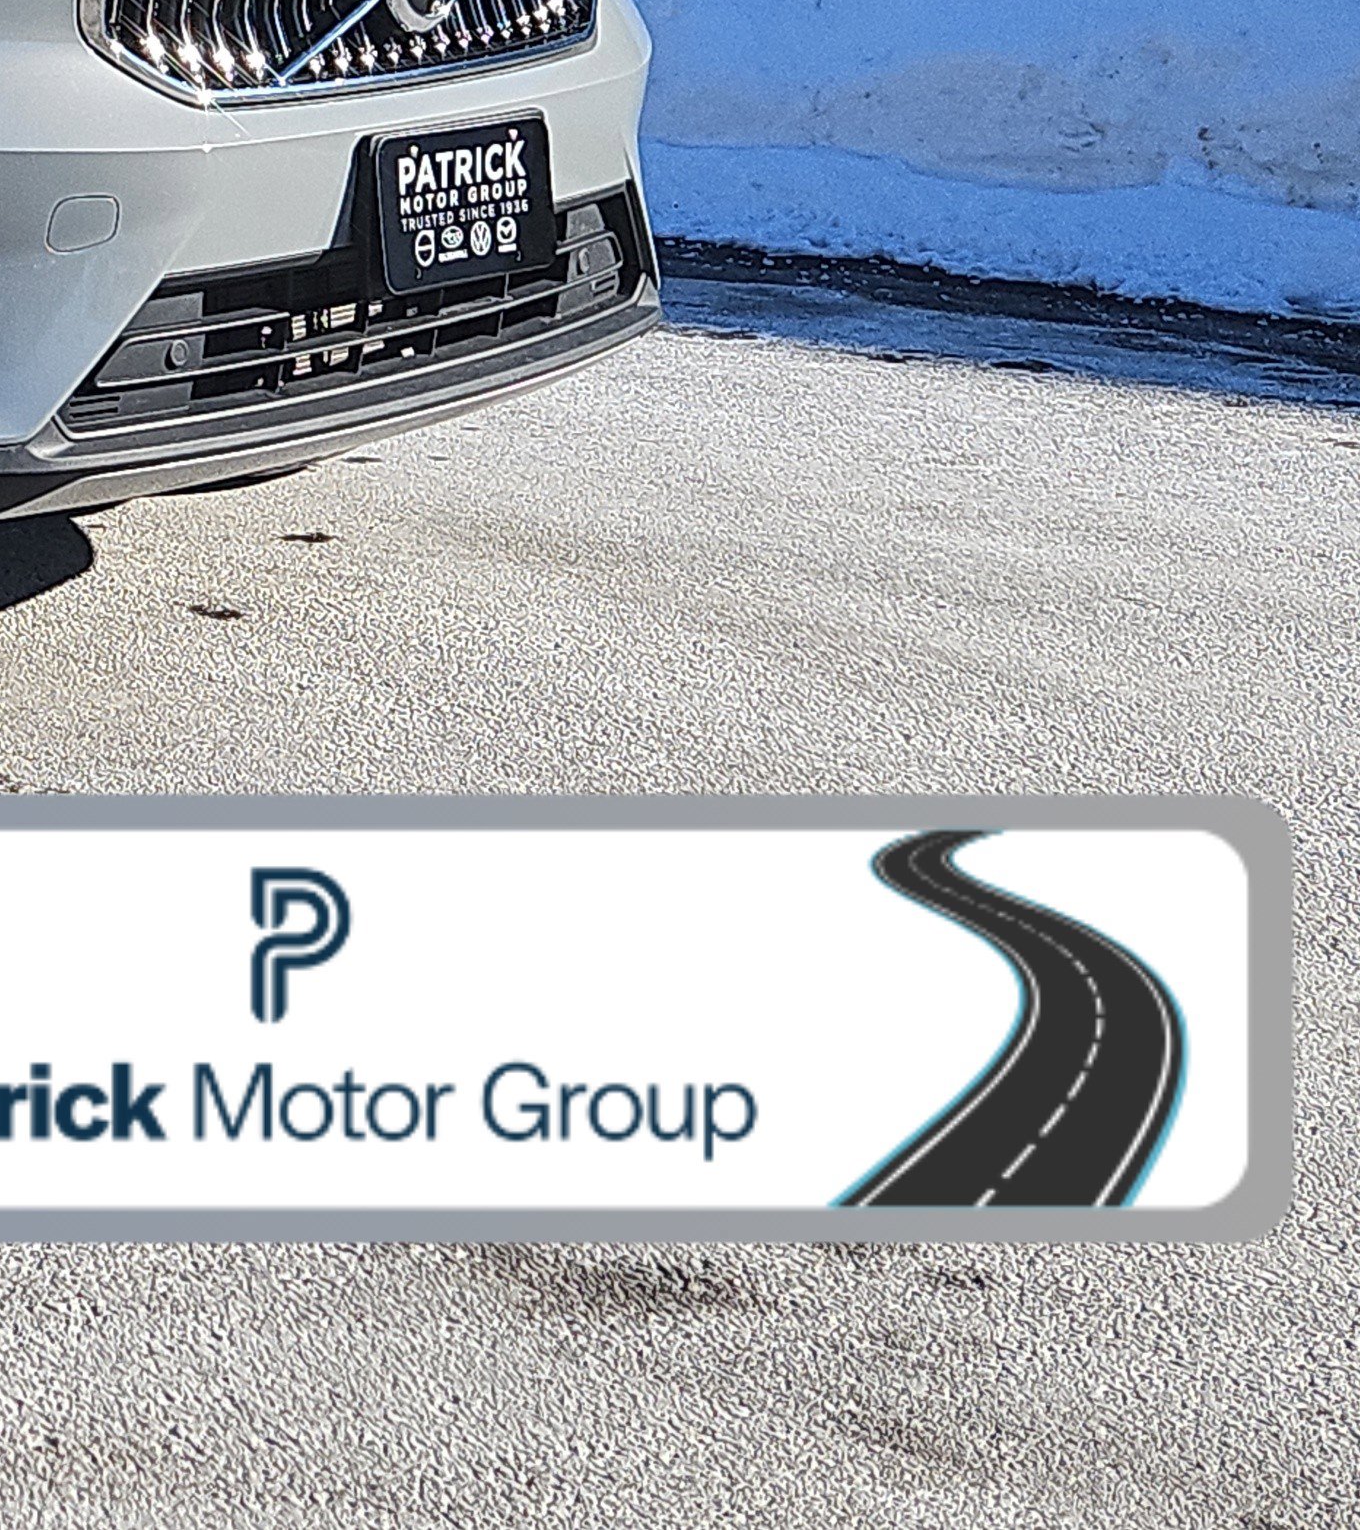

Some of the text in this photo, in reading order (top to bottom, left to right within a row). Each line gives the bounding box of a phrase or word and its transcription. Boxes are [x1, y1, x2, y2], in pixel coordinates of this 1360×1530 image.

[397, 140, 526, 196] PATRICK
[400, 179, 528, 216] MOTOR GROUP
[400, 211, 455, 233] TRUSTED
[459, 203, 496, 223] SINCE
